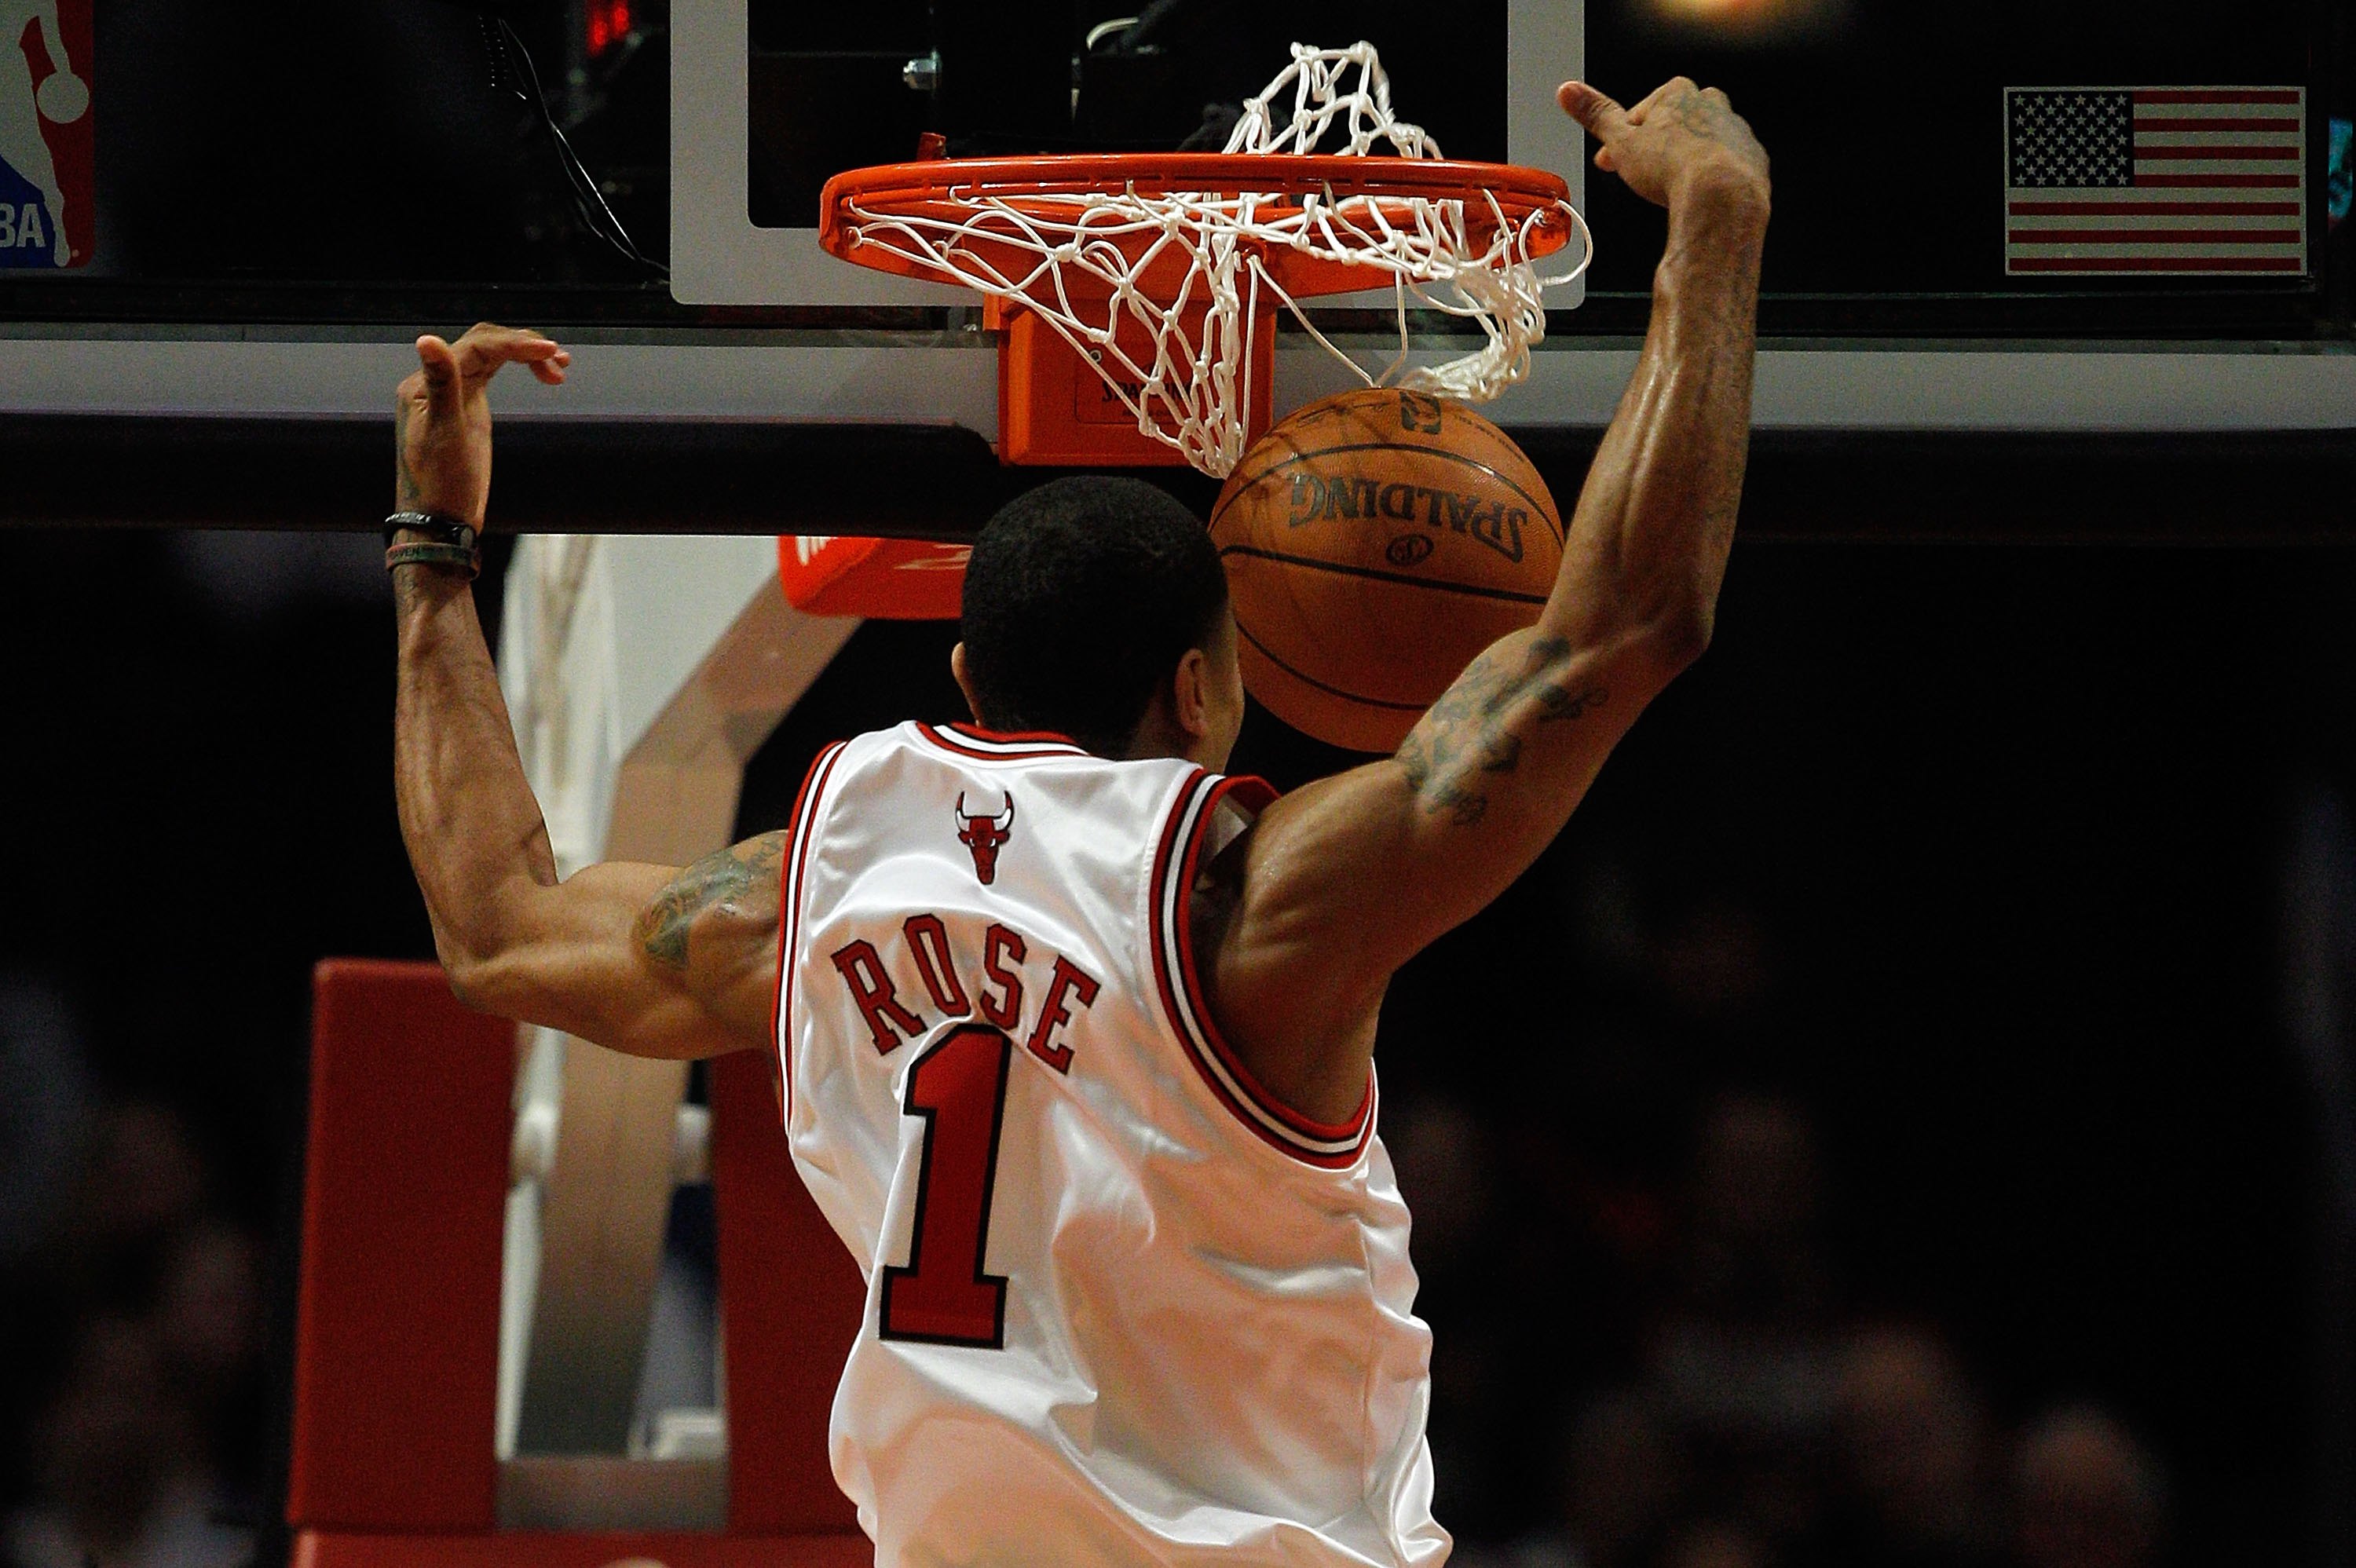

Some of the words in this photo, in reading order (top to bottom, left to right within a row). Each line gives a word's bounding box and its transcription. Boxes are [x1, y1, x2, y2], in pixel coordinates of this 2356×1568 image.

[1286, 473, 1528, 563] SPALDING
[831, 913, 1100, 1076] ROSE
[879, 1022, 1009, 1350] 1
